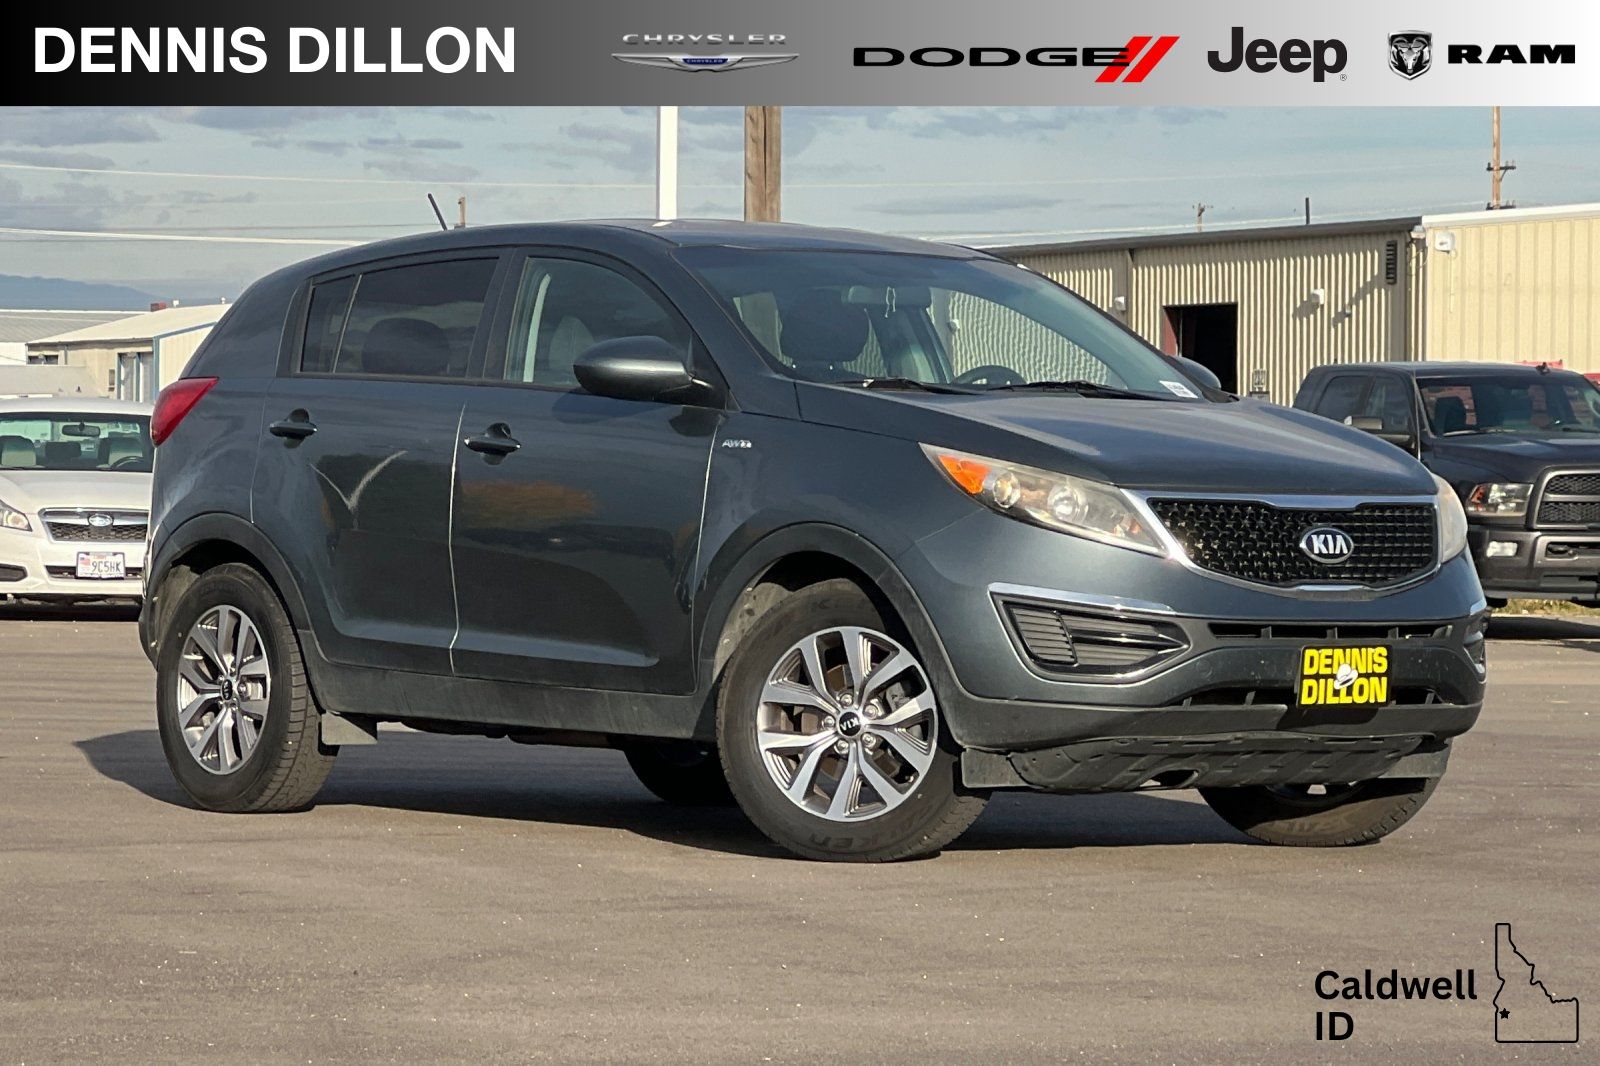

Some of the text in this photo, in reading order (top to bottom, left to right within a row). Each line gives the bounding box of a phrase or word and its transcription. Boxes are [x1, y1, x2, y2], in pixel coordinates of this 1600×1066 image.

[1310, 534, 1349, 555] KIA
[1303, 646, 1388, 675] DENNIS
[1300, 676, 1388, 705] DILLON
[840, 717, 859, 731] KIA
